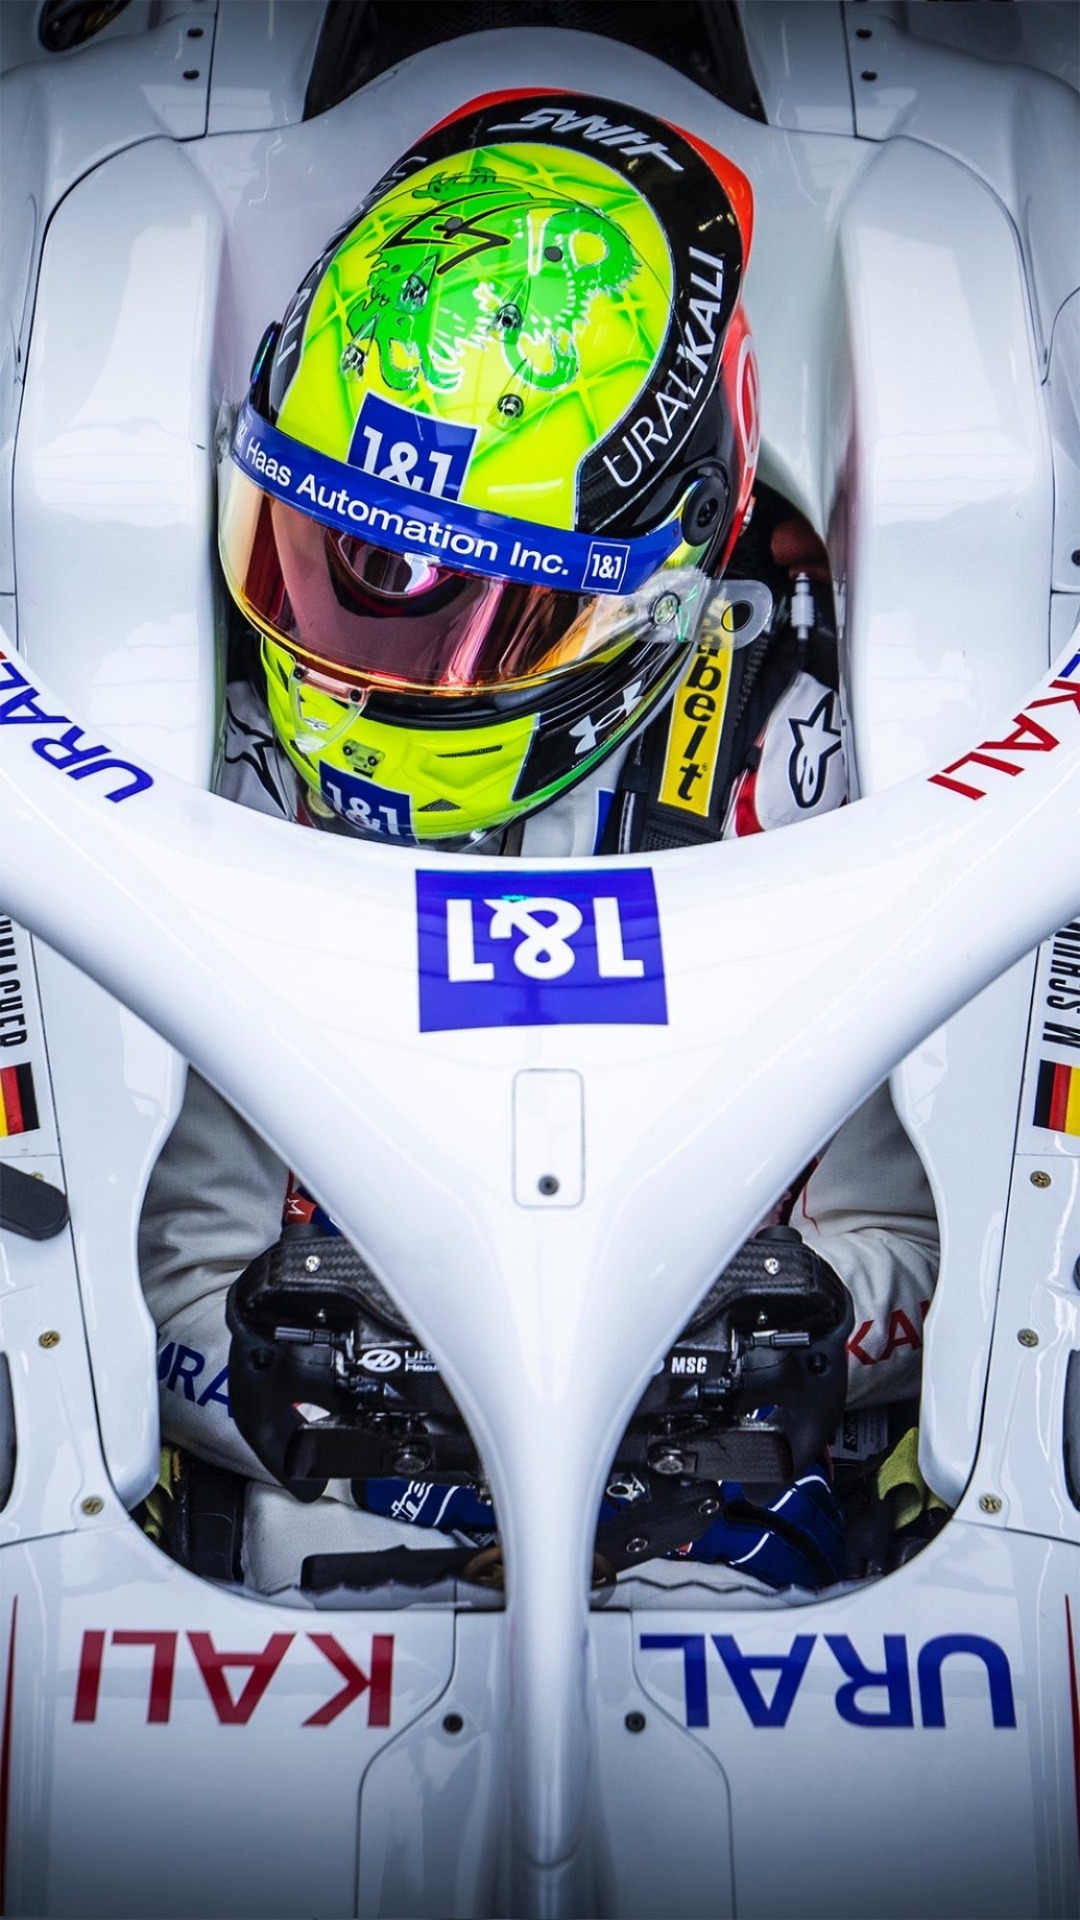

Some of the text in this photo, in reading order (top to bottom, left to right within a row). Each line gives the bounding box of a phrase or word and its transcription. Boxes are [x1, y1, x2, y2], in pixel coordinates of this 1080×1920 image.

[603, 246, 724, 488] URALKALI
[362, 425, 453, 498] 1&1
[246, 436, 292, 487] Haas
[296, 474, 499, 562] Automation
[509, 541, 569, 576] Inc.
[591, 553, 623, 580] 1&1
[0, 651, 154, 804] URAL
[326, 781, 401, 836] 1&1
[446, 897, 645, 983] 1&1
[671, 1356, 708, 1374] MSC
[846, 1299, 931, 1366] KA
[72, 1629, 1018, 1731] URAL KALI
